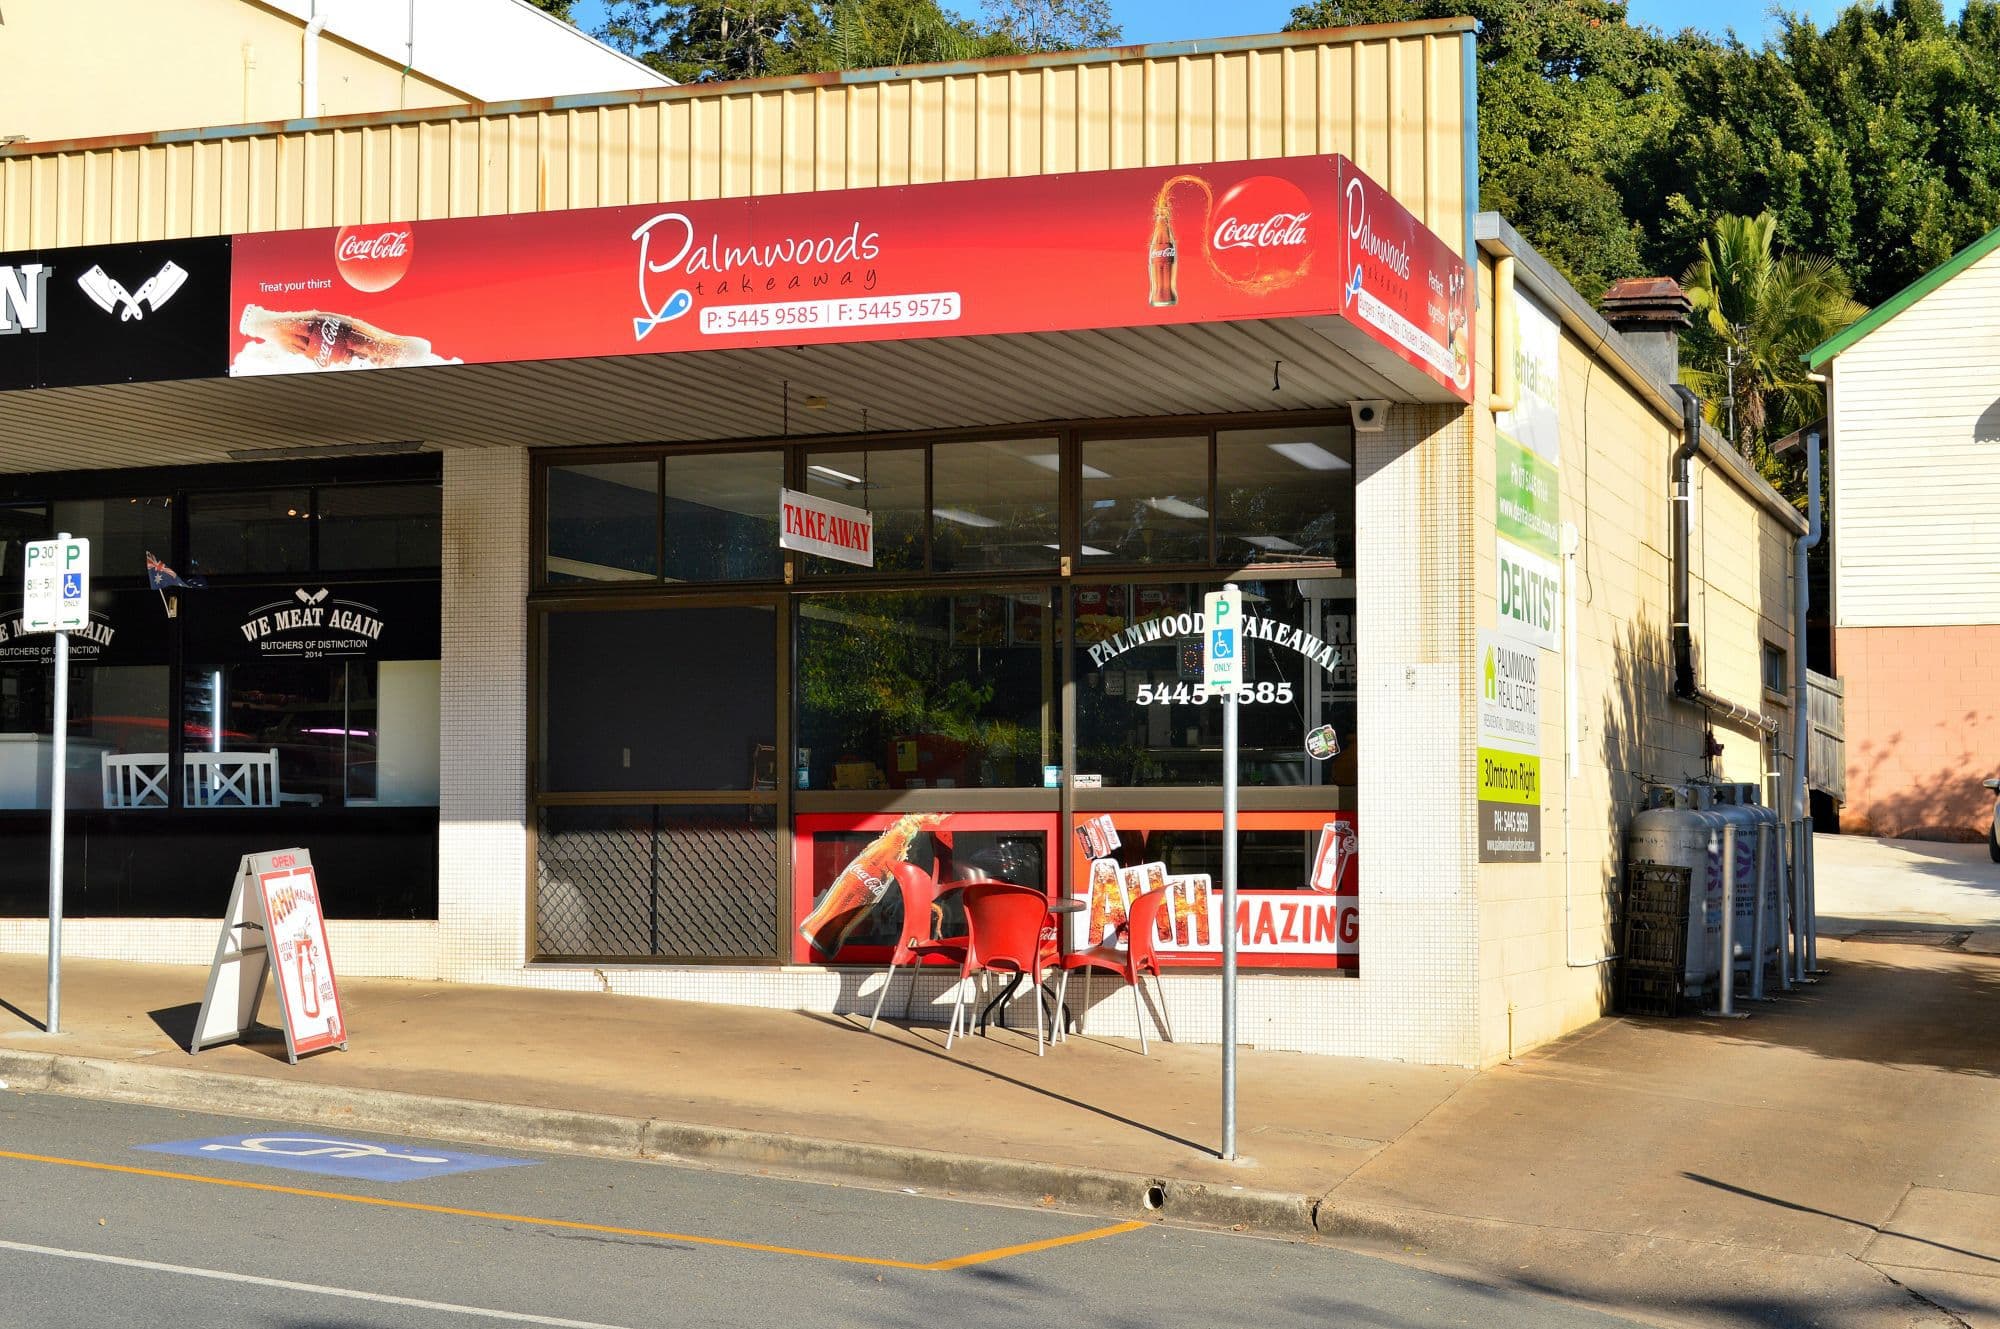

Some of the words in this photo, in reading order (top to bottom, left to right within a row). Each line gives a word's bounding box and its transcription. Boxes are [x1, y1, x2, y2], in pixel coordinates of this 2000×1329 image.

[1213, 212, 1311, 250] Coca-Cola
[1346, 177, 1410, 288] Palmwoods
[338, 232, 410, 262] Coca-Cola
[632, 213, 880, 312] Palmwoods
[259, 282, 282, 294] Treat
[284, 281, 306, 293] your
[307, 279, 333, 290] thirst
[694, 269, 878, 296] takeaway
[707, 312, 722, 328] P:
[727, 308, 770, 328] 5445
[775, 305, 818, 324] 9585
[838, 303, 852, 321] F:
[858, 300, 901, 320] 5445
[908, 297, 952, 316] 9575
[783, 503, 870, 552] TAKEAWAY
[28, 547, 39, 568] P
[66, 545, 80, 569] P
[1501, 558, 1558, 633] DENTIST
[241, 616, 271, 642] WE
[274, 607, 324, 631] MEAT
[329, 609, 384, 641] AGAIN
[1216, 601, 1230, 625] P
[41, 647, 52, 655] OF
[261, 641, 303, 650] BUTCHERS
[305, 641, 316, 649] OF
[318, 640, 368, 649] DISTINCTION
[305, 651, 323, 659] 2014
[1087, 612, 1205, 668] PALMWOOD
[1214, 663, 1231, 672] ONLY
[1497, 646, 1536, 685] PALMWOODS
[1136, 682, 1209, 705] 5445
[1220, 681, 1293, 705] 585
[1498, 680, 1515, 710] REAL
[1516, 684, 1536, 715] ESTATE
[1510, 768, 1519, 790] on
[1520, 763, 1536, 799] Right
[271, 853, 296, 869] OPEN
